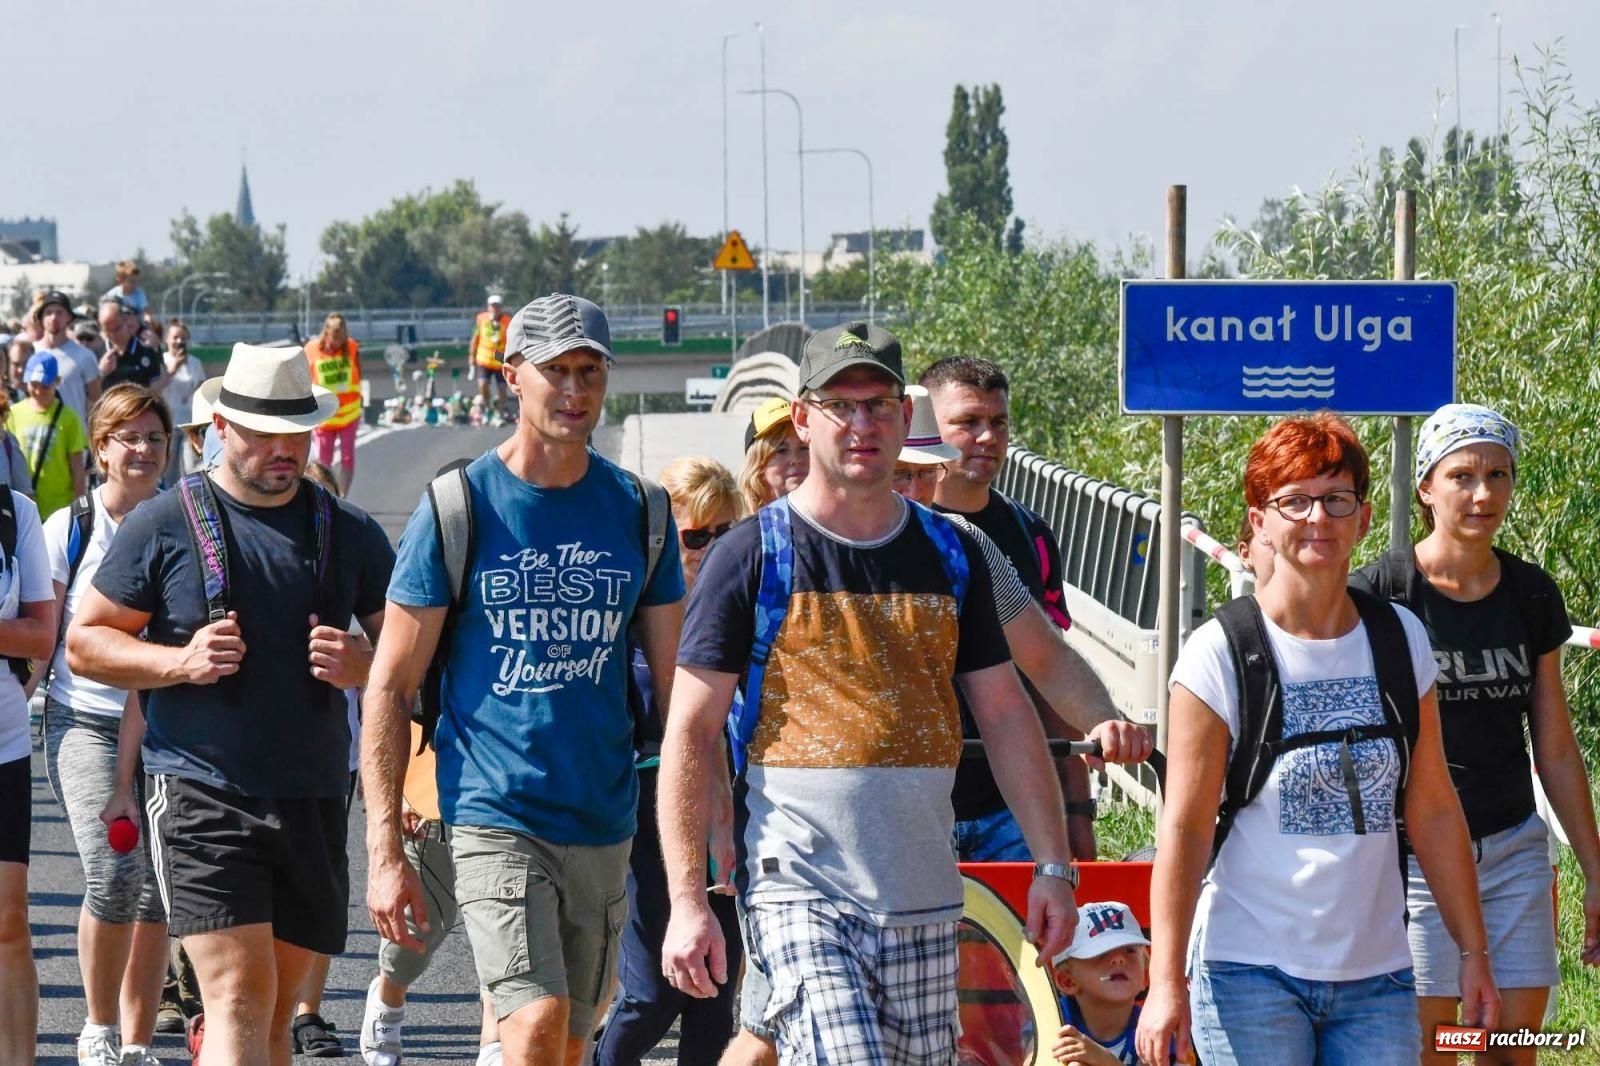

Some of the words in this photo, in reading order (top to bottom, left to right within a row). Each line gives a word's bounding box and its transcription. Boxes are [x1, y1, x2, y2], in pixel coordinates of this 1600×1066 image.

[1166, 304, 1296, 342] kanał
[1314, 304, 1413, 352] Ulga
[499, 548, 549, 571] Be
[556, 541, 612, 567] The
[481, 567, 631, 605] BEST
[484, 607, 623, 643] VERSION
[547, 644, 572, 658] OF
[1432, 644, 1531, 683] RUN
[490, 645, 612, 696] Yourself
[1485, 682, 1532, 699] WAY
